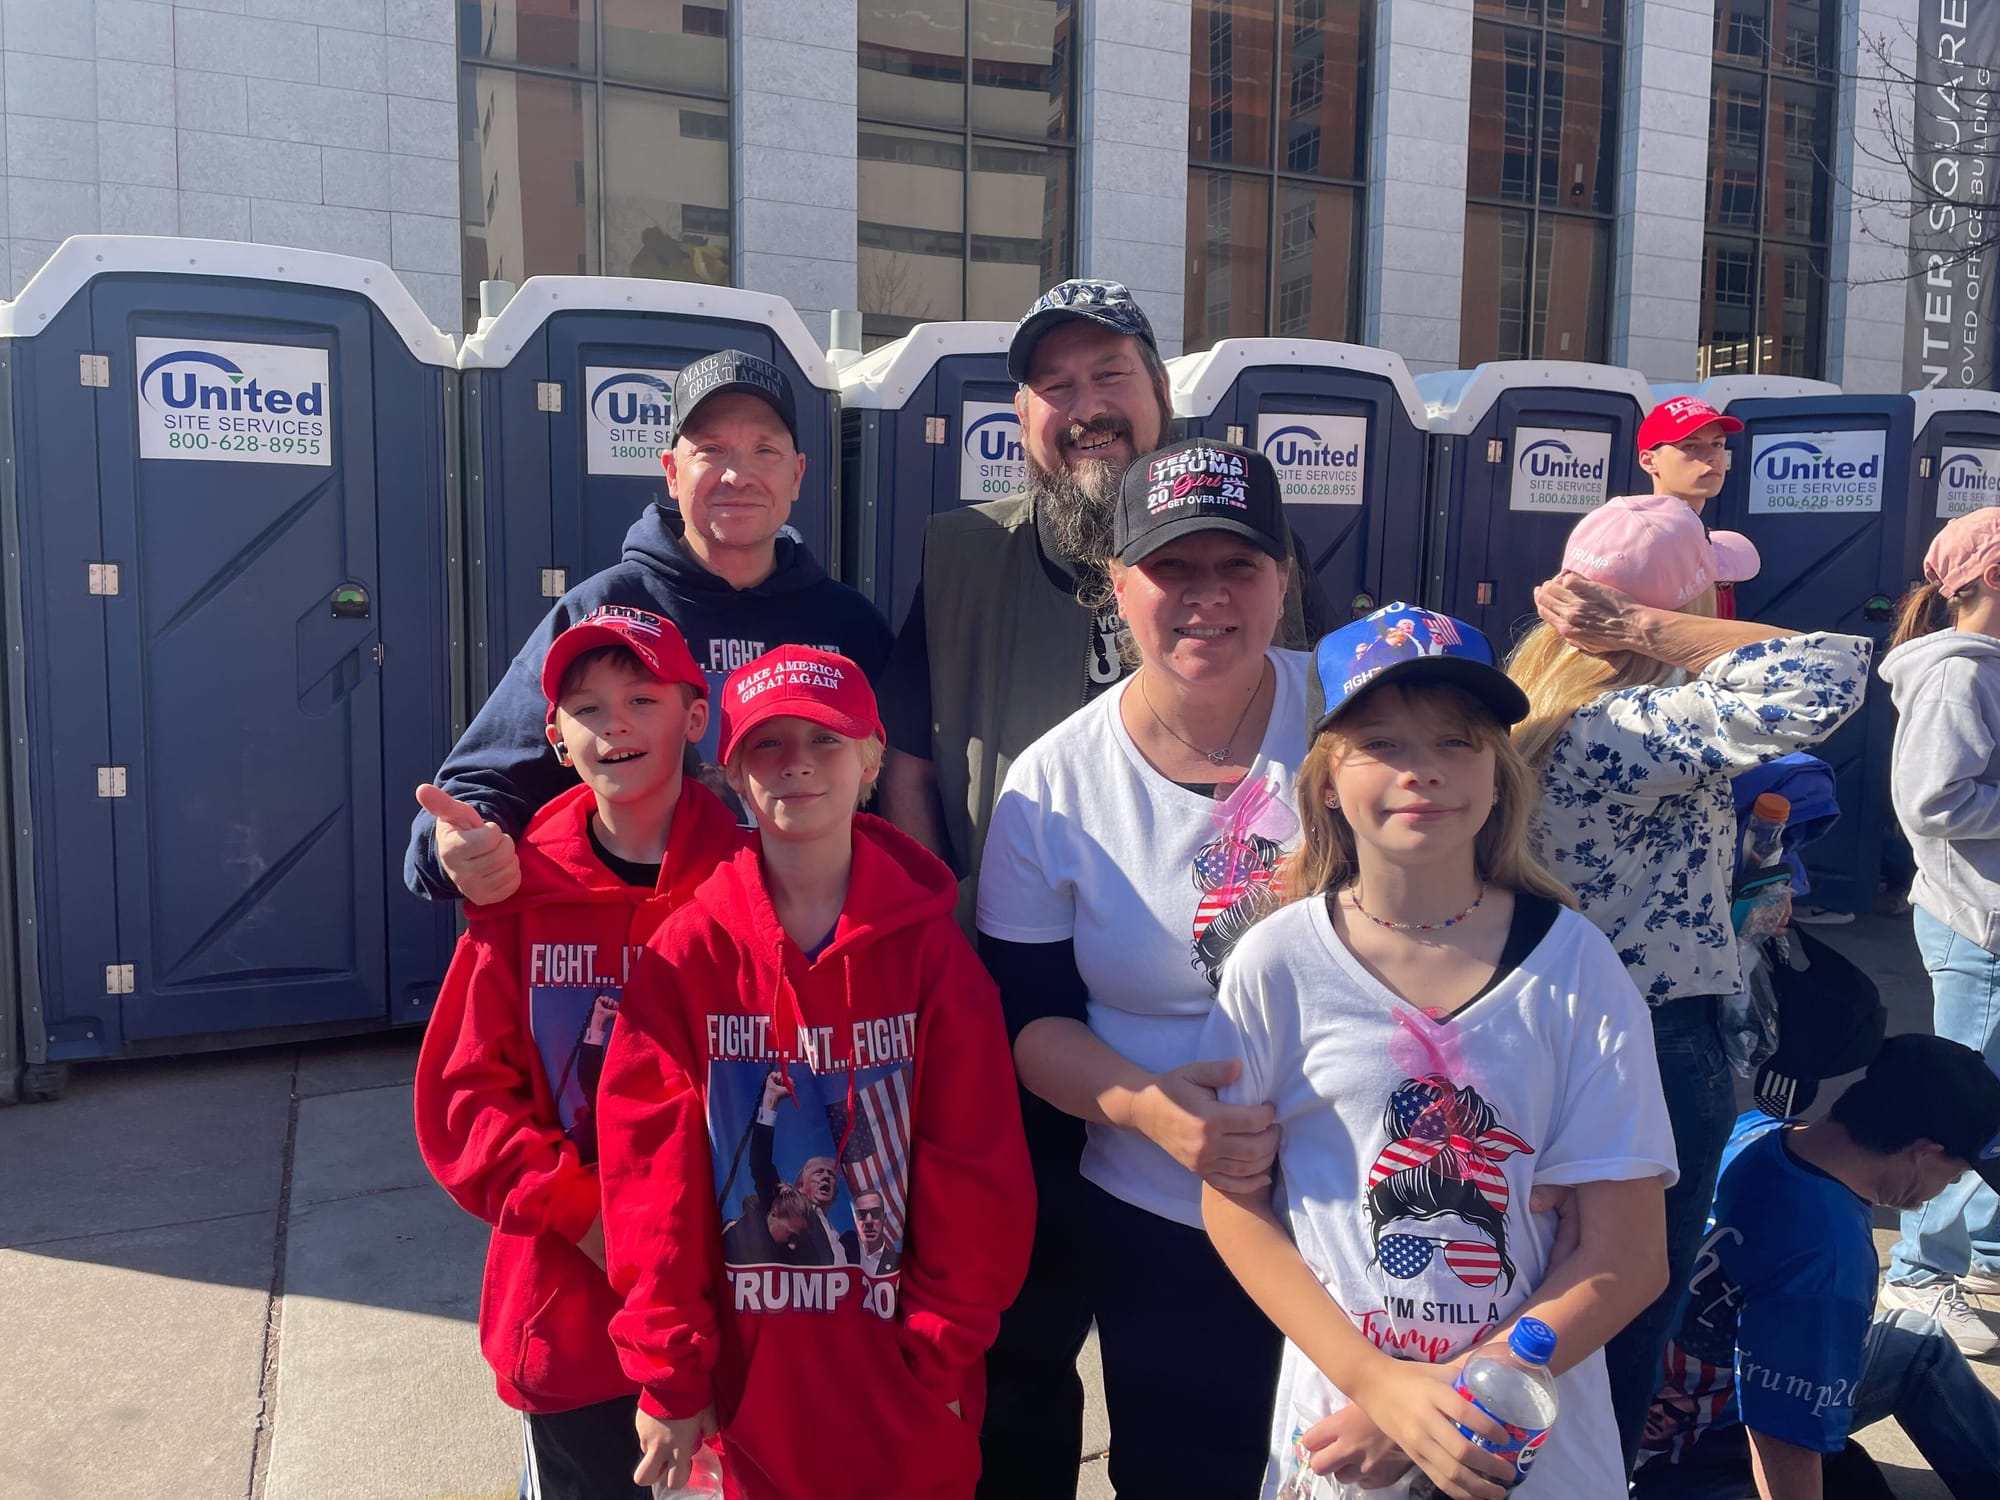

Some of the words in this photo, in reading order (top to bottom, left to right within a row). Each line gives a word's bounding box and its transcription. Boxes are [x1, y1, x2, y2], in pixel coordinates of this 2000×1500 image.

[1929, 0, 1968, 233] SQUARE
[1921, 254, 1954, 391] NTER
[1961, 310, 1978, 385] OVED
[681, 356, 719, 387] MAKE
[723, 353, 784, 387] AERICA
[688, 366, 732, 399] GREAT
[740, 367, 781, 399] AGAIN
[161, 371, 323, 417] United
[608, 392, 671, 426] Uni
[164, 414, 210, 431] SITE
[218, 416, 323, 437] SERVICES
[610, 428, 647, 443] SITE
[169, 432, 321, 455] 800-628-8955
[611, 446, 665, 459] 1800TO
[1276, 441, 1359, 467] United
[980, 464, 1013, 478] SITE
[1153, 459, 1244, 481] TRUMP
[1230, 456, 1242, 467] A
[1530, 453, 1604, 480] United
[1767, 454, 1879, 480] United
[1173, 472, 1223, 498] Girl
[1277, 469, 1302, 480] SITE
[1306, 470, 1358, 482] SERVICES
[1529, 480, 1553, 490] SITE
[1556, 481, 1602, 493] SERVICES
[1147, 488, 1170, 509] 20
[1221, 484, 1246, 501] 24
[1281, 483, 1356, 496] .800.628.8955
[1529, 492, 1600, 506] 1.800.628.8955
[1766, 483, 1798, 495] SITE
[1802, 482, 1877, 494] SERVICES
[1947, 491, 1968, 502] SITE
[1167, 497, 1187, 509] GET
[1187, 495, 1215, 505] OVER
[1216, 496, 1229, 506] IT!
[1768, 495, 1873, 508] 800-628-8955
[736, 667, 771, 694] MAKE
[774, 660, 845, 680] AMERICA
[741, 674, 785, 704] GREAT
[788, 672, 839, 690] AGAIN
[726, 1270, 851, 1312] RUMP
[1384, 1295, 1415, 1319] I'M
[1422, 1301, 1480, 1324] STILL
[1487, 1302, 1500, 1323] A
[1350, 1309, 1458, 1364] Trump
